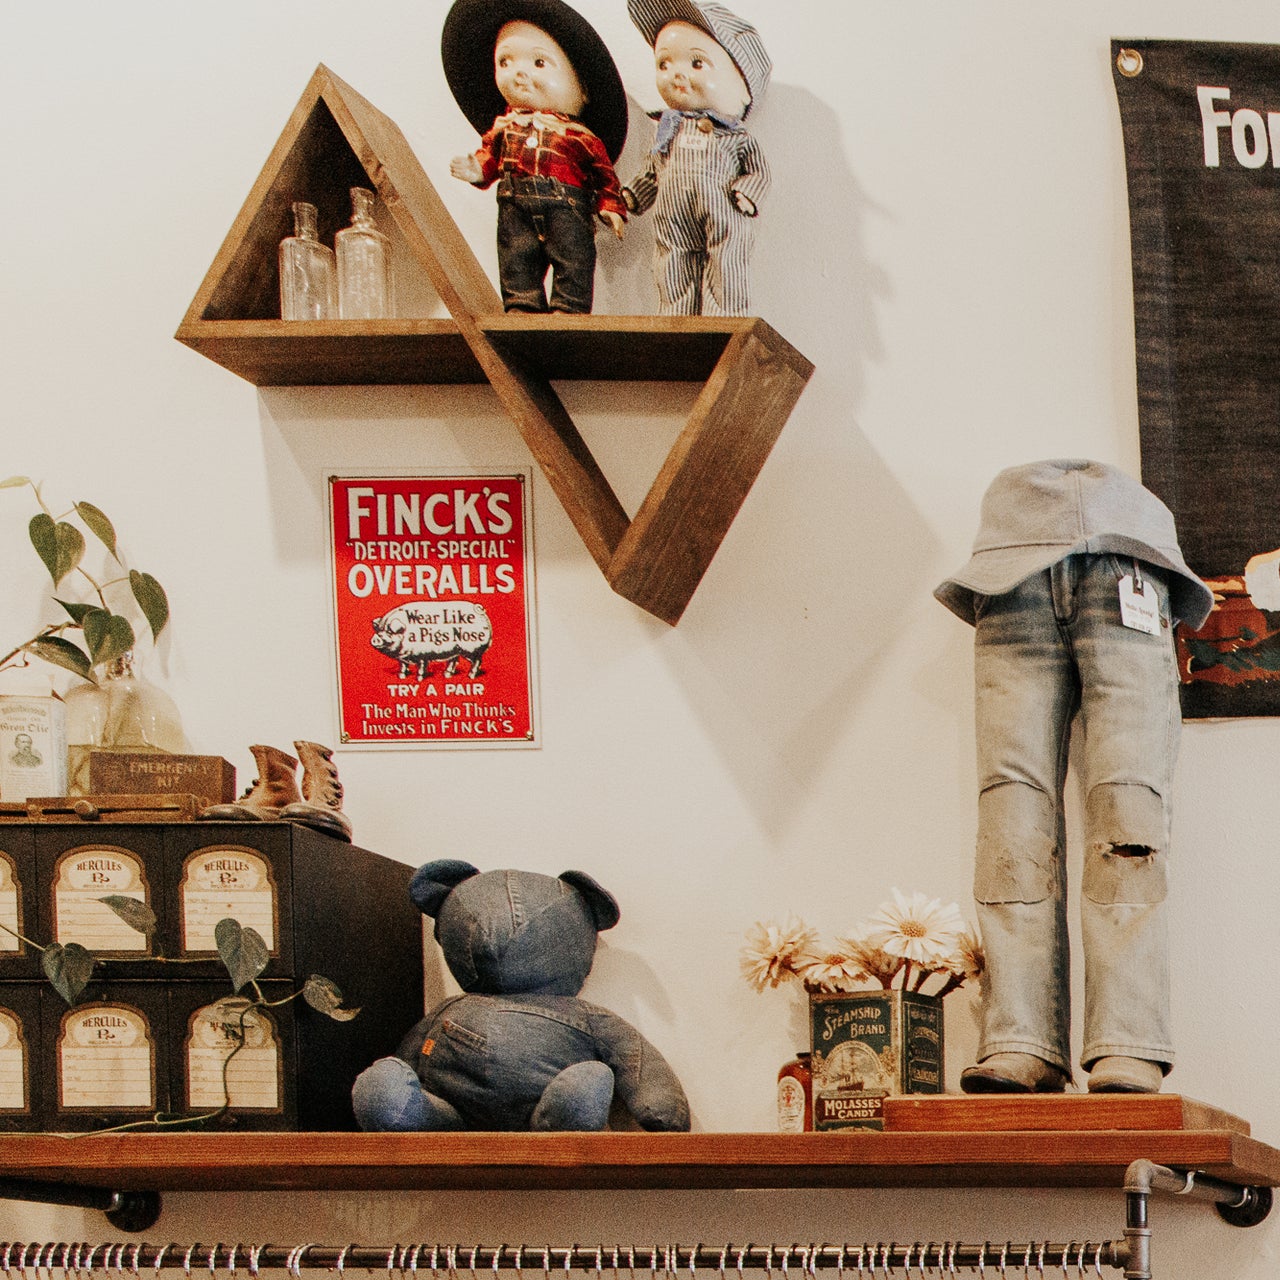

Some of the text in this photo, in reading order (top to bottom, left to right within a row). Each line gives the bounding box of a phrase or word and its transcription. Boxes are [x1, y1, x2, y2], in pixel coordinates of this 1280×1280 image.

[346, 486, 514, 540] FINCK'S
[347, 562, 517, 599] OVERALLS
[442, 608, 476, 625] Like
[407, 630, 417, 643] a
[386, 683, 486, 697] TRY A PAIR
[360, 701, 517, 720] The Man Who Thinks
[361, 717, 515, 736] Invests in FINCK'S
[77, 859, 122, 871] HERCULES
[204, 859, 250, 872] HERCULES
[82, 1016, 127, 1028] HERCULES
[823, 1006, 882, 1041] STEAMSHIP
[850, 1023, 886, 1039] BRAND
[824, 1098, 882, 1117] MOLASSES
[837, 1109, 876, 1119] CANDY
